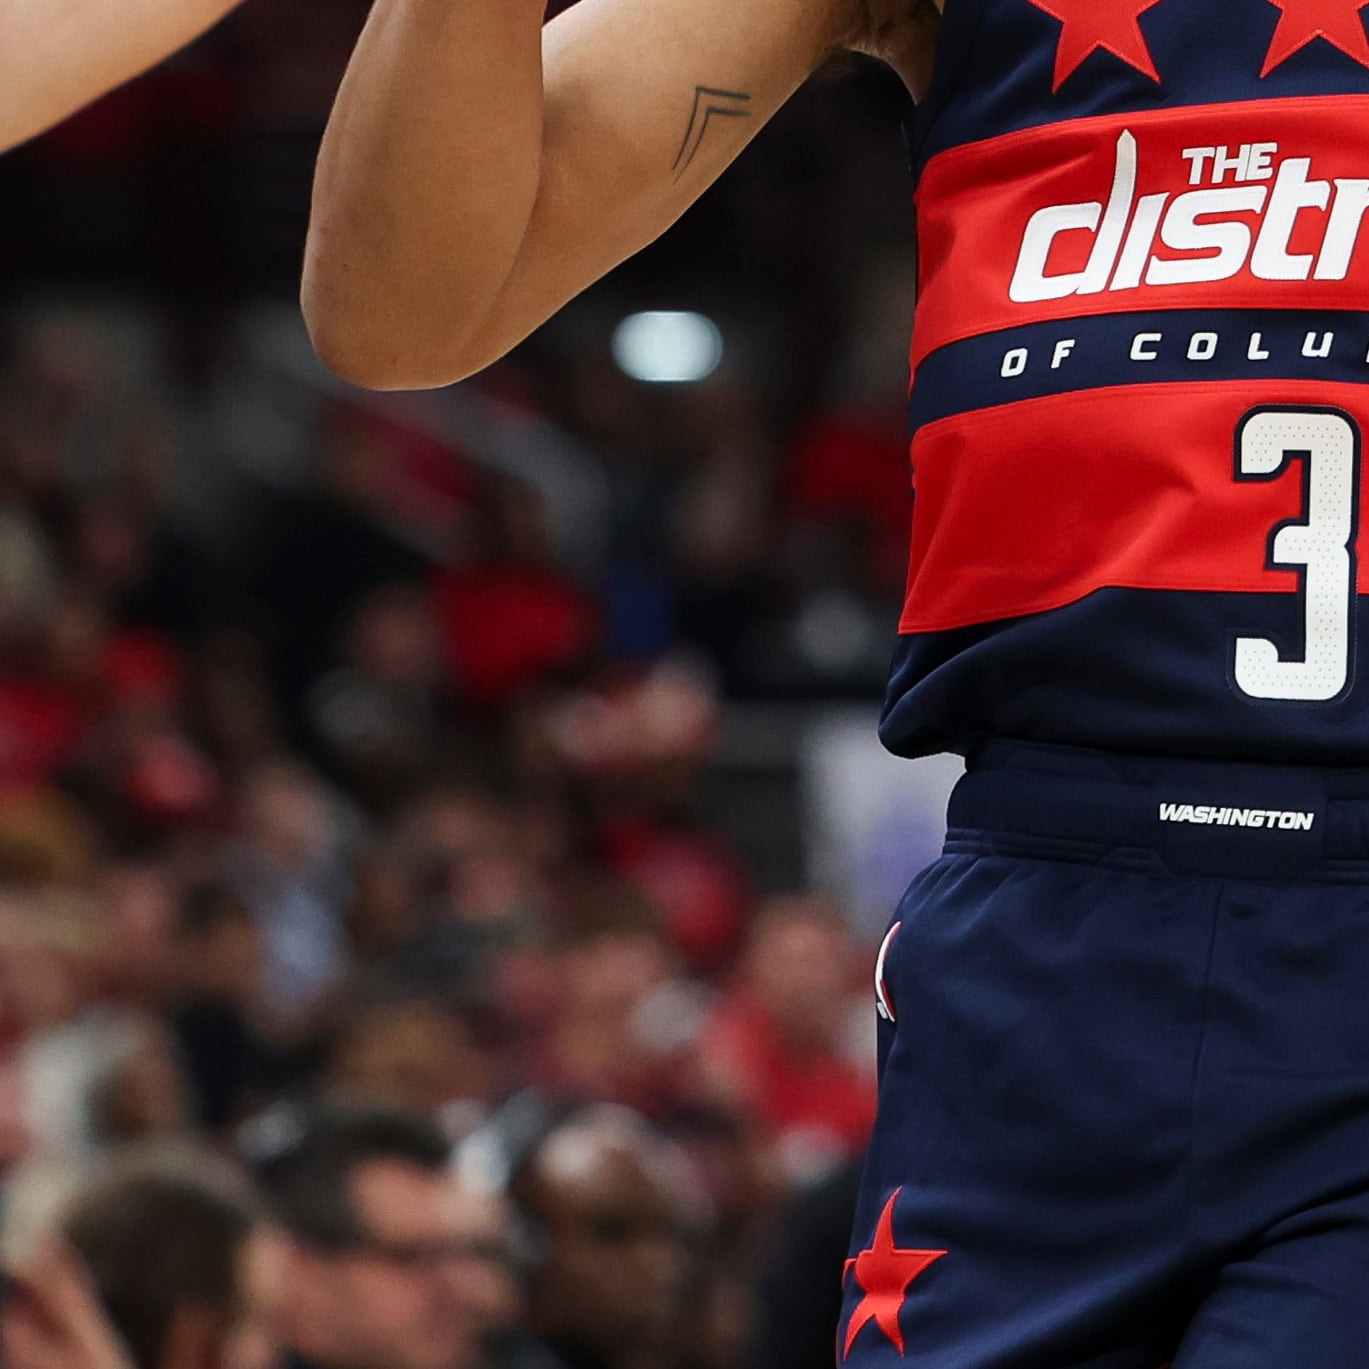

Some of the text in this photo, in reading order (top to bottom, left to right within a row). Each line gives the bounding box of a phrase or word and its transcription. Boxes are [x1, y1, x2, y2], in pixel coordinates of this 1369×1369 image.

[1182, 142, 1278, 185] THE
[1000, 339, 1076, 378] OF
[1233, 410, 1358, 702] 3
[1158, 802, 1316, 831] WASHINGTON
